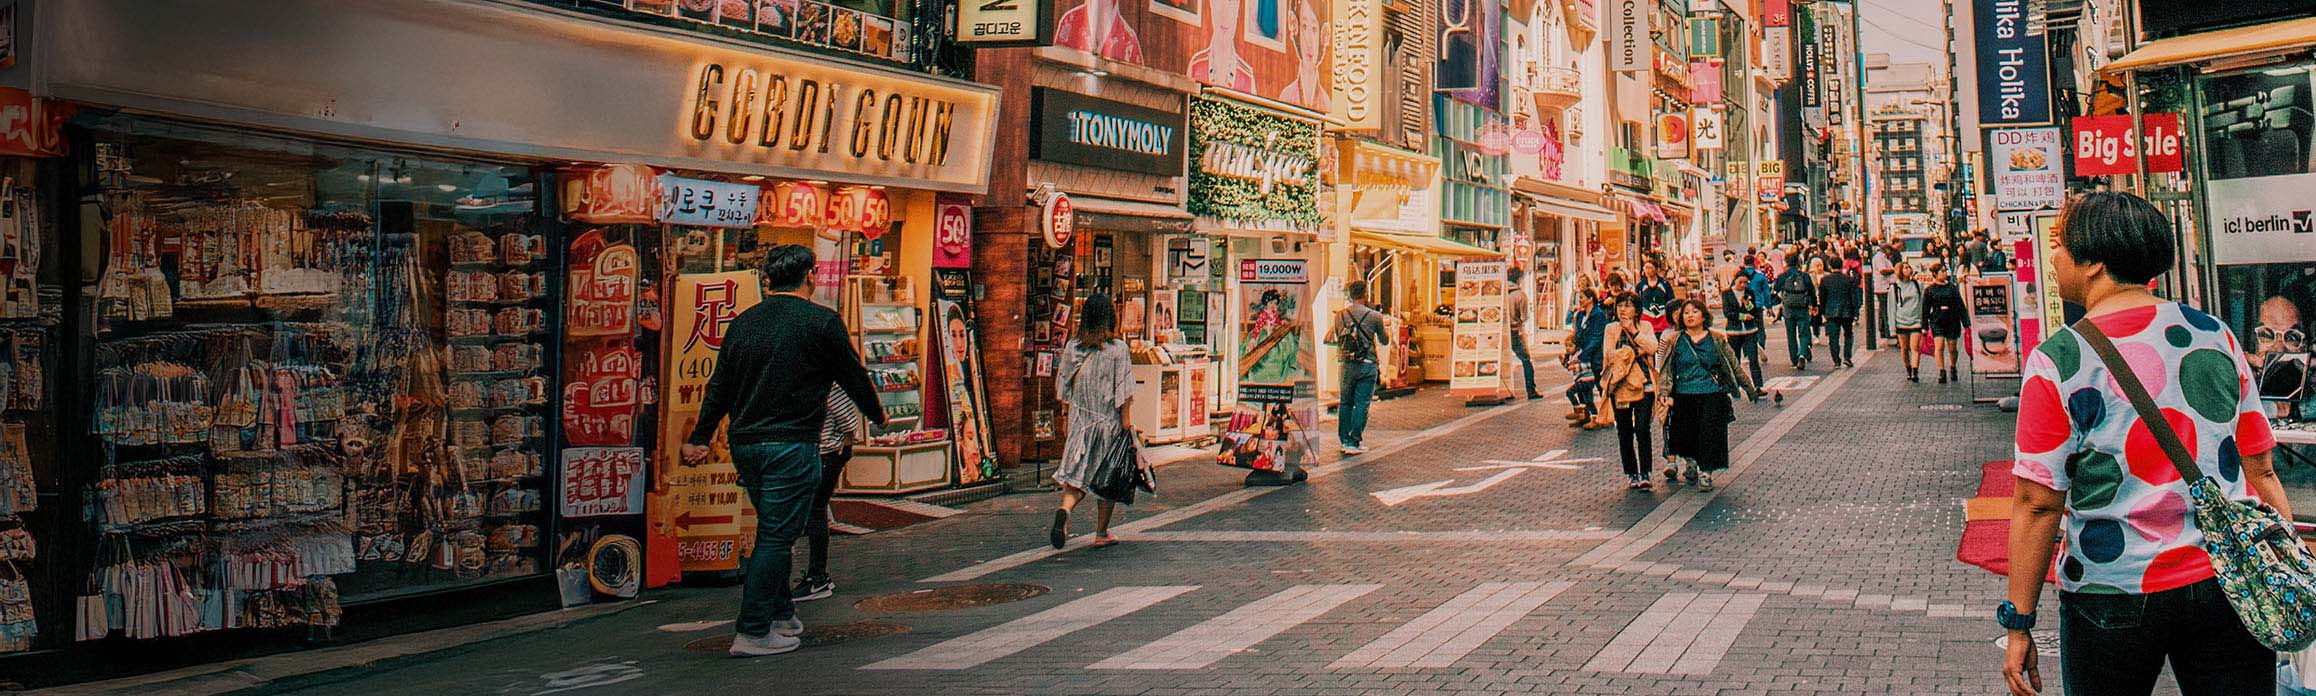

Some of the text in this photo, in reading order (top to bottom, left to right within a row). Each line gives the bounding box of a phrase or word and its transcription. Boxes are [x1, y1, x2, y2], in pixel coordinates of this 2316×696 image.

[974, 22, 1021, 36] 곱디고운
[1773, 14, 1786, 24] 3F
[1622, 0, 1636, 66] Collection
[1805, 44, 1814, 71] HOLLYS
[1998, 47, 2026, 120] Holika
[1072, 110, 1173, 156] TONYMOLY
[1697, 118, 1717, 140] 光
[1997, 131, 2022, 145] DD
[2078, 129, 2119, 166] Big
[1761, 163, 1781, 174] BIG
[2224, 214, 2290, 234] ic! berlin
[683, 279, 738, 352] 足
[720, 541, 734, 560] 3F
